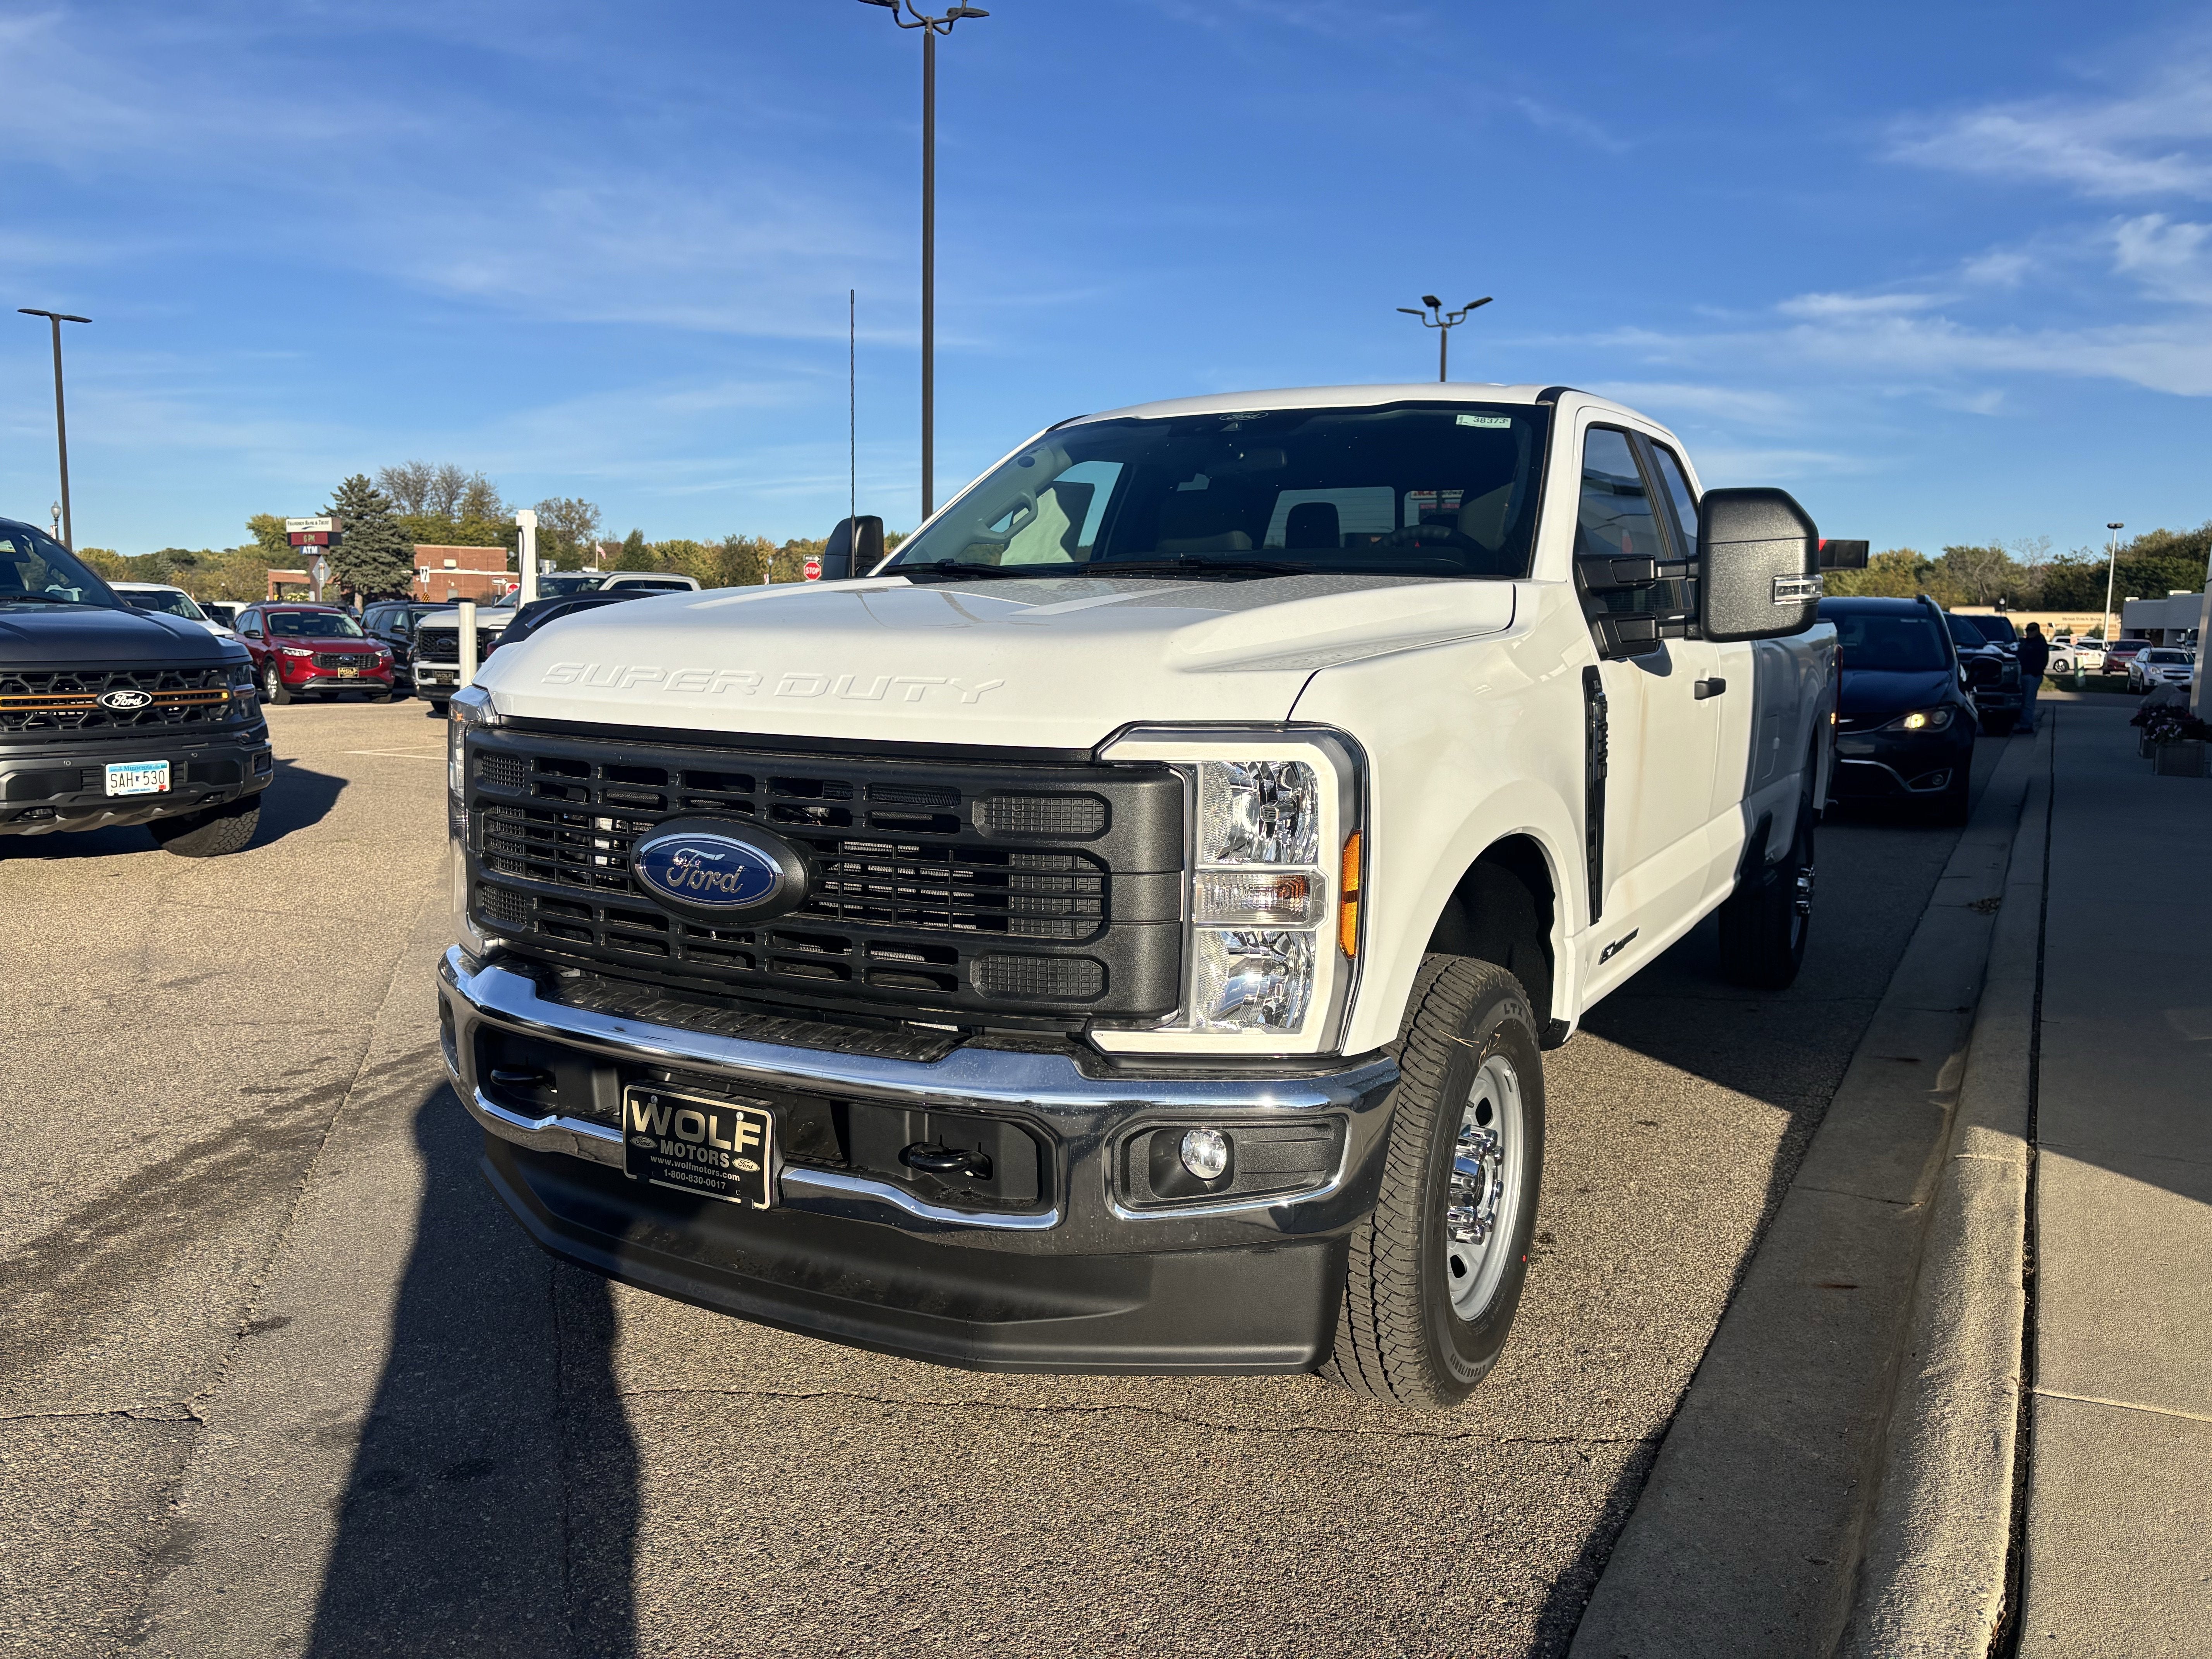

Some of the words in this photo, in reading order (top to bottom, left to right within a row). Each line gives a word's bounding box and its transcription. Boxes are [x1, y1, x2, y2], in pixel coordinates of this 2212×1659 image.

[302, 546, 318, 554] ATM
[805, 567, 820, 575] STOP
[541, 662, 764, 695] SUPER
[775, 672, 1005, 703] DUTY
[1593, 680, 1601, 689] XL
[112, 693, 143, 706] Ford
[111, 772, 134, 788] SAH
[143, 770, 165, 785] 530
[666, 848, 745, 894] Ford
[1504, 1003, 1523, 1018] LTX
[631, 1099, 761, 1153] WOLF
[660, 1139, 730, 1168] MOTORS
[650, 1156, 740, 1182] www.wolfmotors.com
[664, 1169, 726, 1189] 1-800-830-0017
